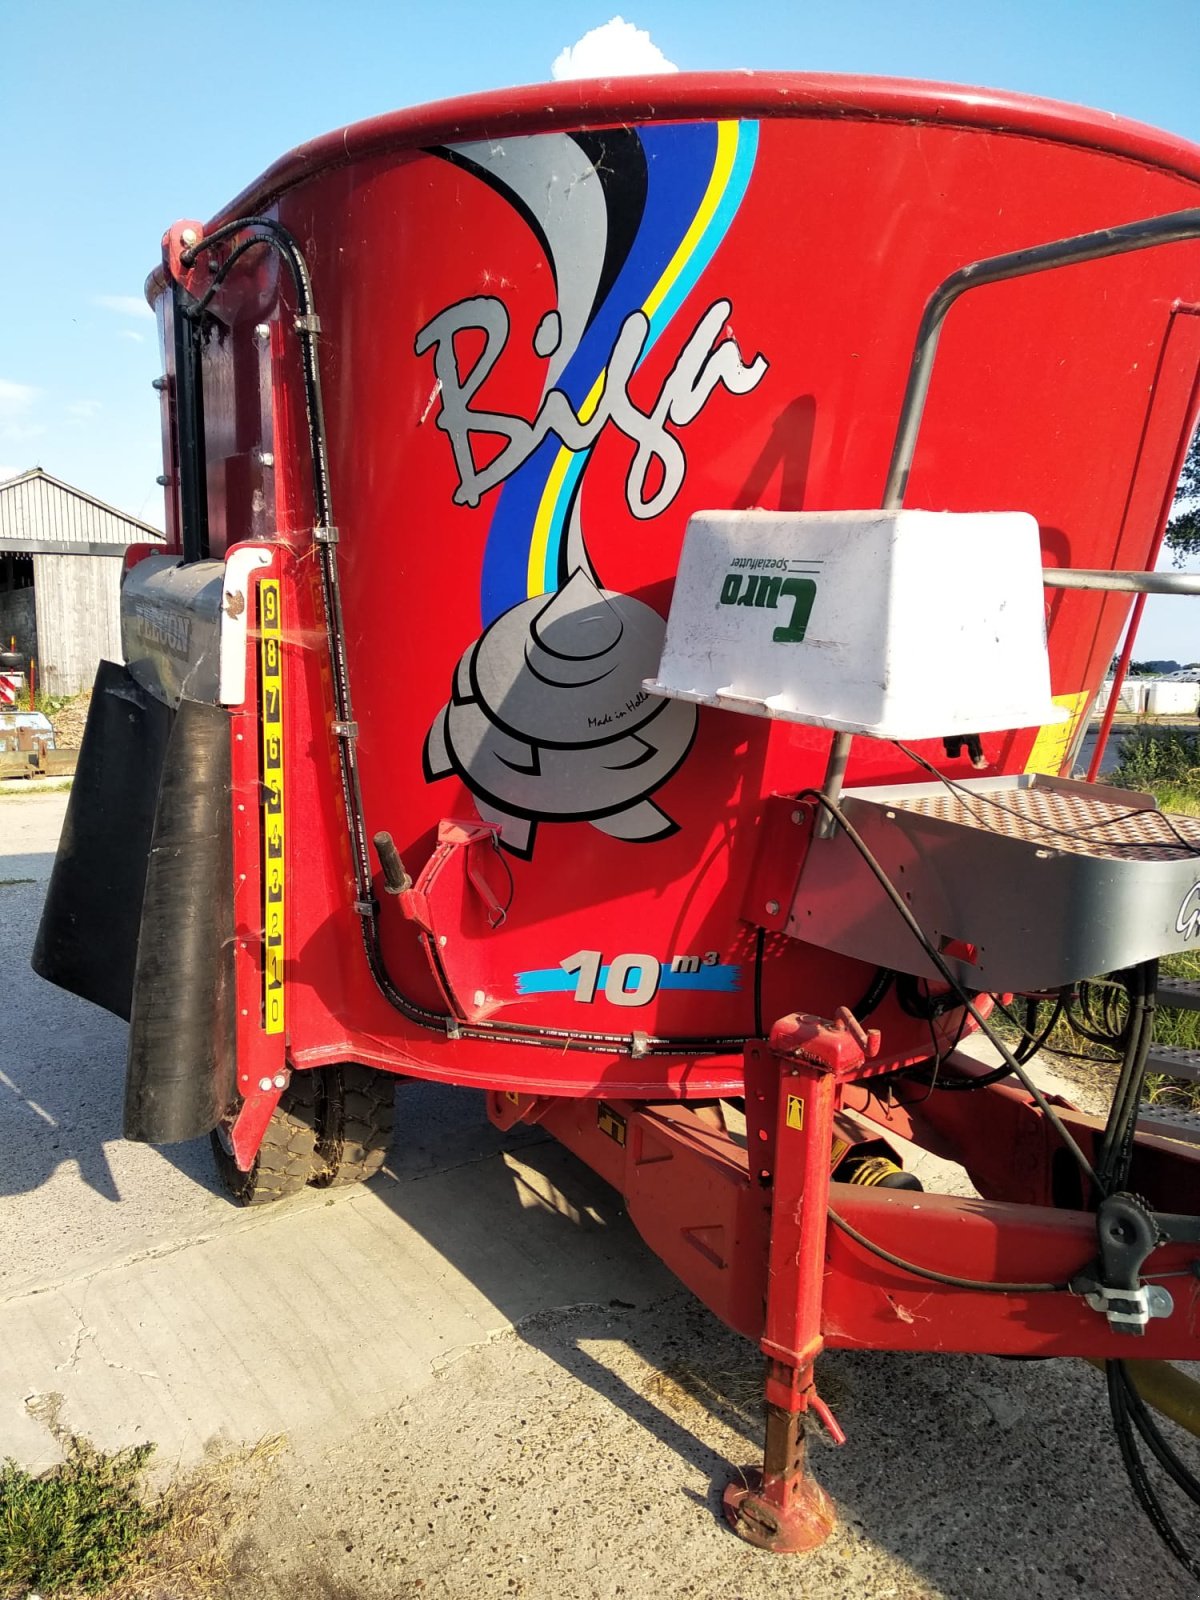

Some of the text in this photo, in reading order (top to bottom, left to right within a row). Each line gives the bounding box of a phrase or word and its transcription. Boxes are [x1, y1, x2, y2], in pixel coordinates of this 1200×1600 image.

[730, 558, 790, 572] Spezialfutter
[266, 592, 276, 620] 9
[720, 573, 817, 643] Curo
[267, 639, 277, 667] 8
[268, 686, 278, 713] 7
[588, 714, 613, 728] Made
[614, 711, 627, 719] in
[269, 734, 278, 760] 6
[270, 779, 279, 805] 5
[271, 824, 279, 849] 4
[271, 868, 279, 894] 3
[271, 912, 279, 938] 2
[271, 956, 278, 981] 1
[559, 949, 664, 1007] 10
[271, 999, 279, 1022] 0
